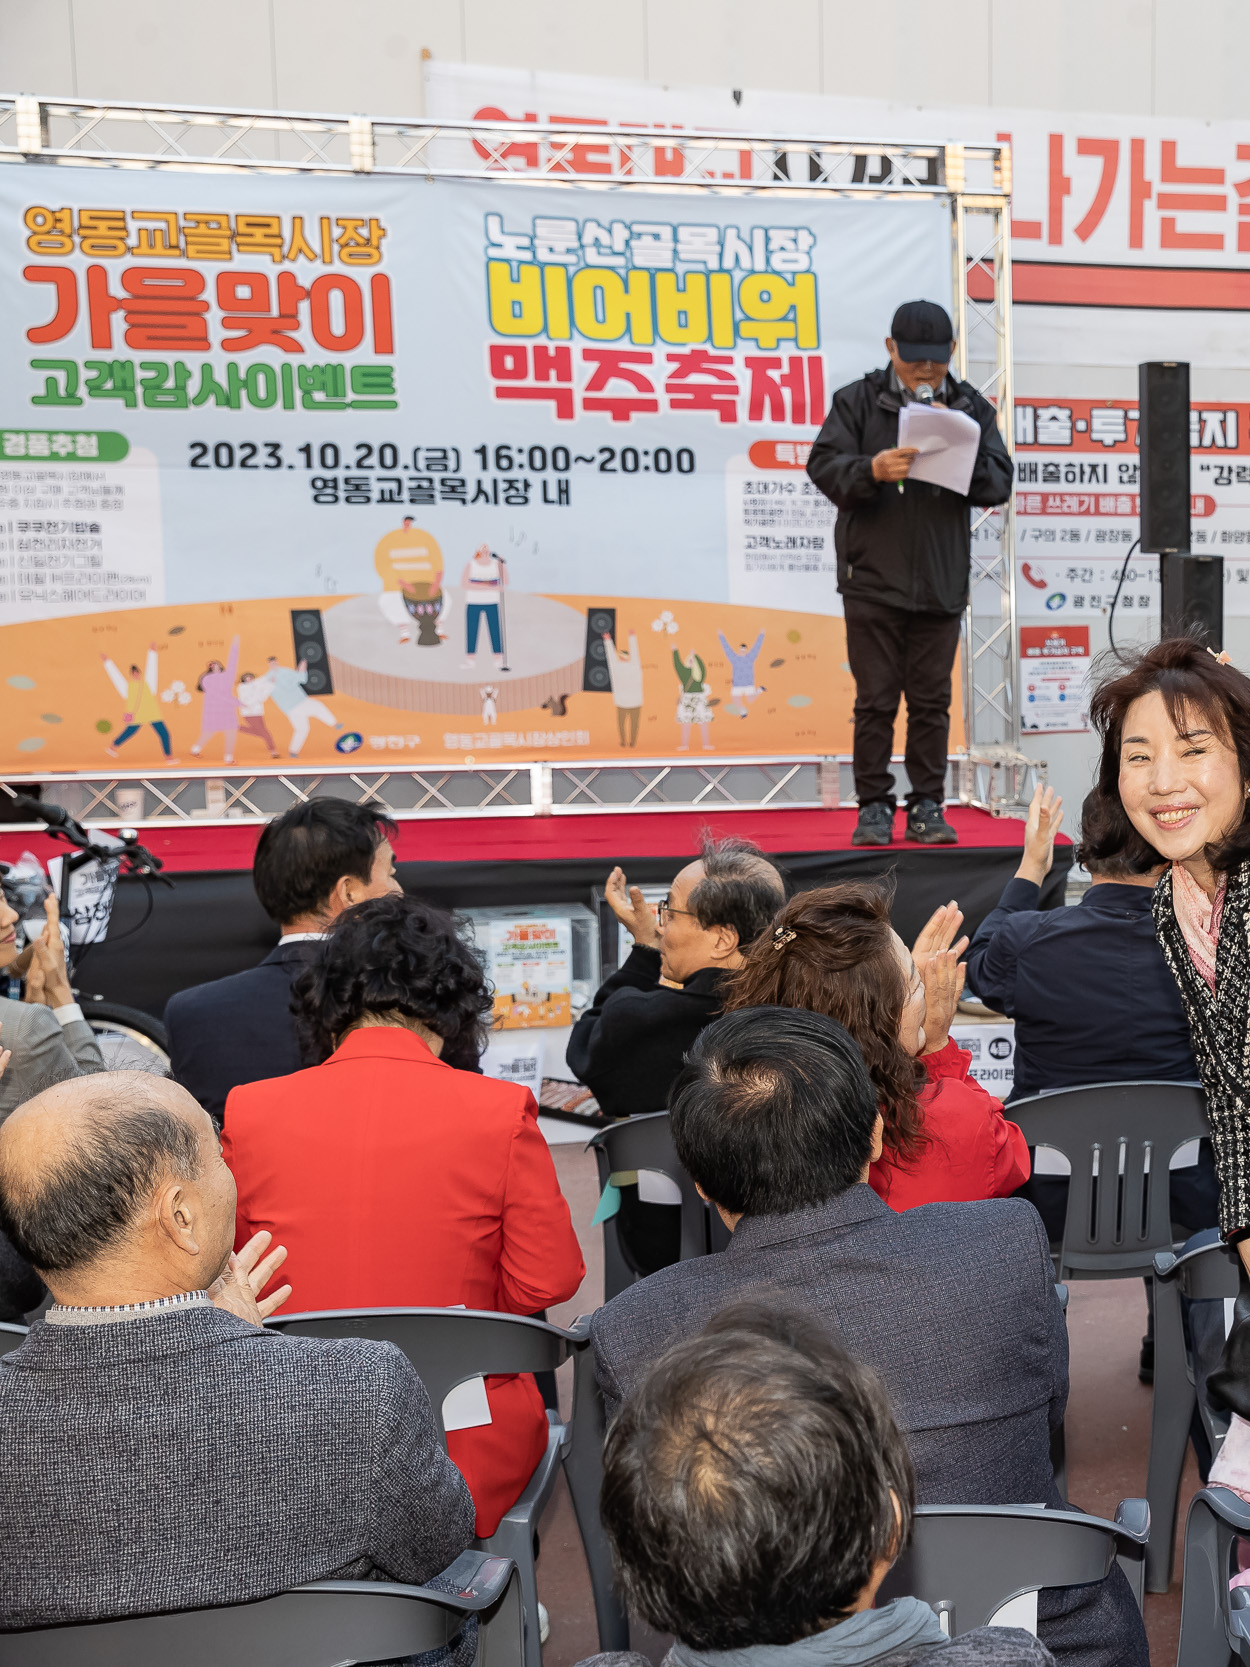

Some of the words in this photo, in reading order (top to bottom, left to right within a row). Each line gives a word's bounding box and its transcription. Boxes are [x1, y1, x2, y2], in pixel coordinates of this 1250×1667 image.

[24, 206, 387, 265] 영동교골목시장
[485, 213, 816, 273] 노룬산골목시장
[23, 265, 395, 354] 가을맞이
[486, 261, 820, 350] 비어비워
[29, 359, 399, 410] 고객감사이벤트
[488, 344, 828, 425] 맥주축제
[2, 433, 99, 457] 경품추첨
[474, 444, 696, 475] 16:00~20:00
[310, 475, 531, 506] 영동교골목시장
[542, 478, 570, 506] 내
[1018, 463, 1107, 484] 배출하지
[1046, 495, 1096, 514] 쓰레기
[1098, 496, 1133, 515] 배출
